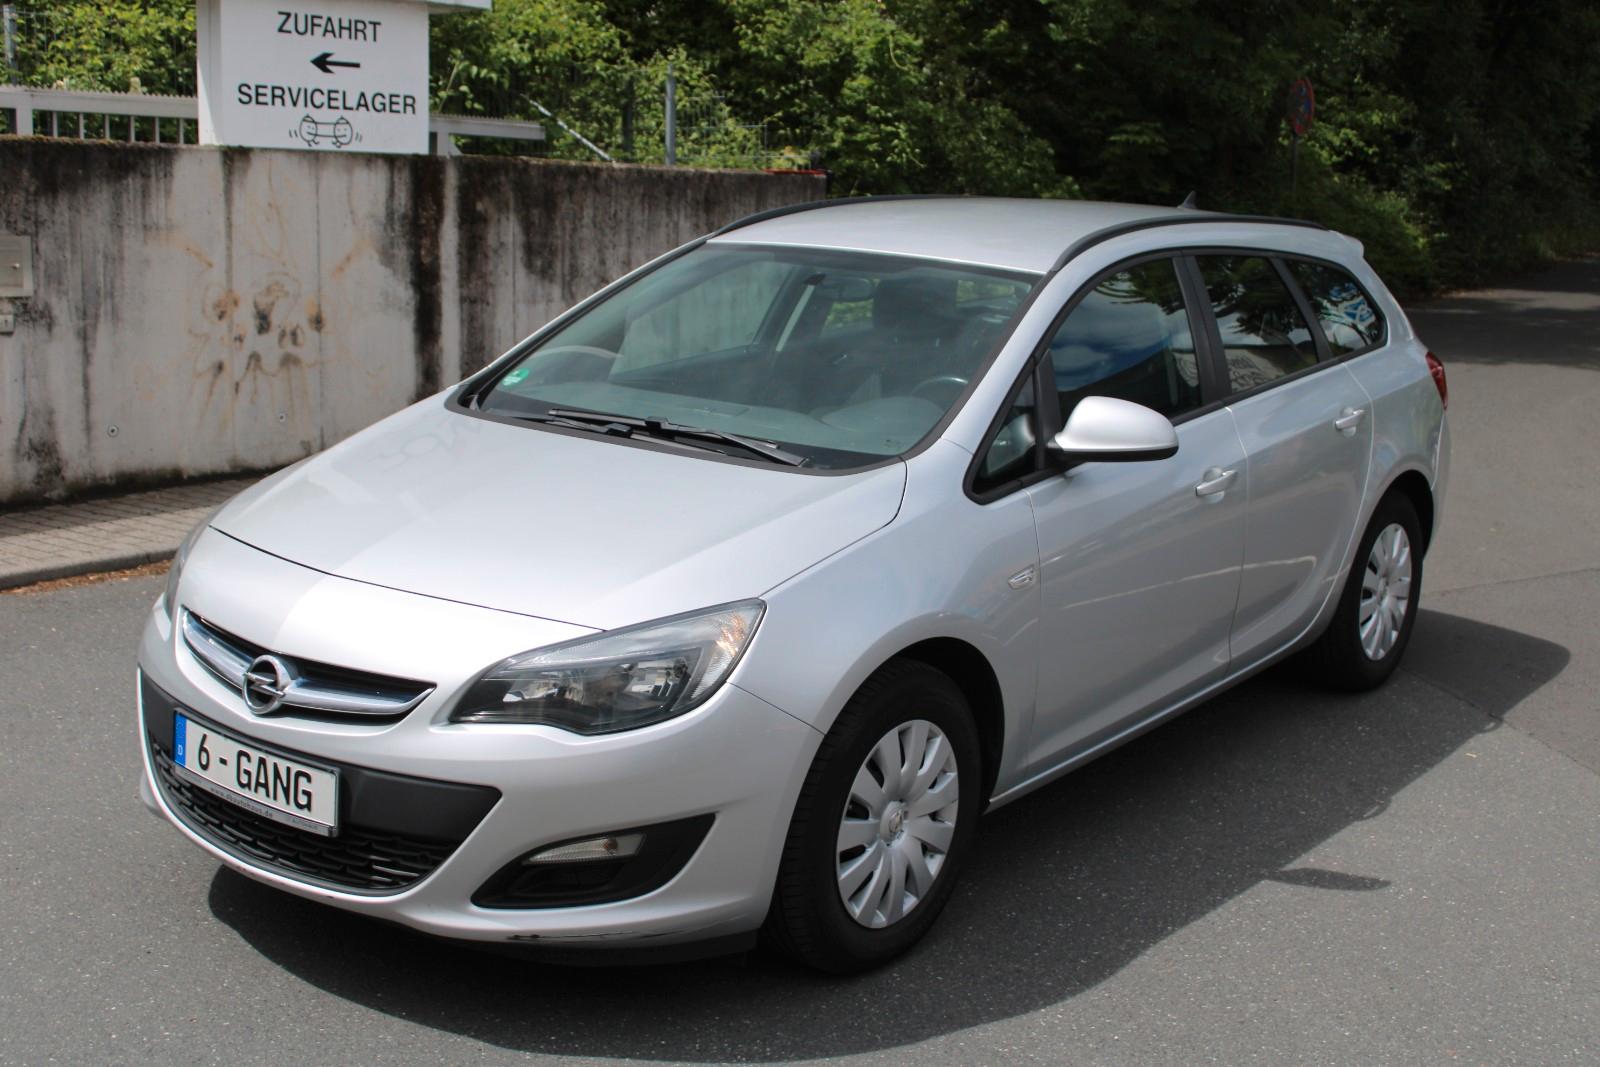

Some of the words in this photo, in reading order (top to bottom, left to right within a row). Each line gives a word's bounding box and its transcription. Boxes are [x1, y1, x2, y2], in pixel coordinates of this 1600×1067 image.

[277, 11, 382, 42] ZUFAHRT
[238, 83, 416, 115] SERVICELAGER
[177, 744, 183, 756] D
[198, 733, 210, 771] 6
[236, 749, 312, 813] GANG
